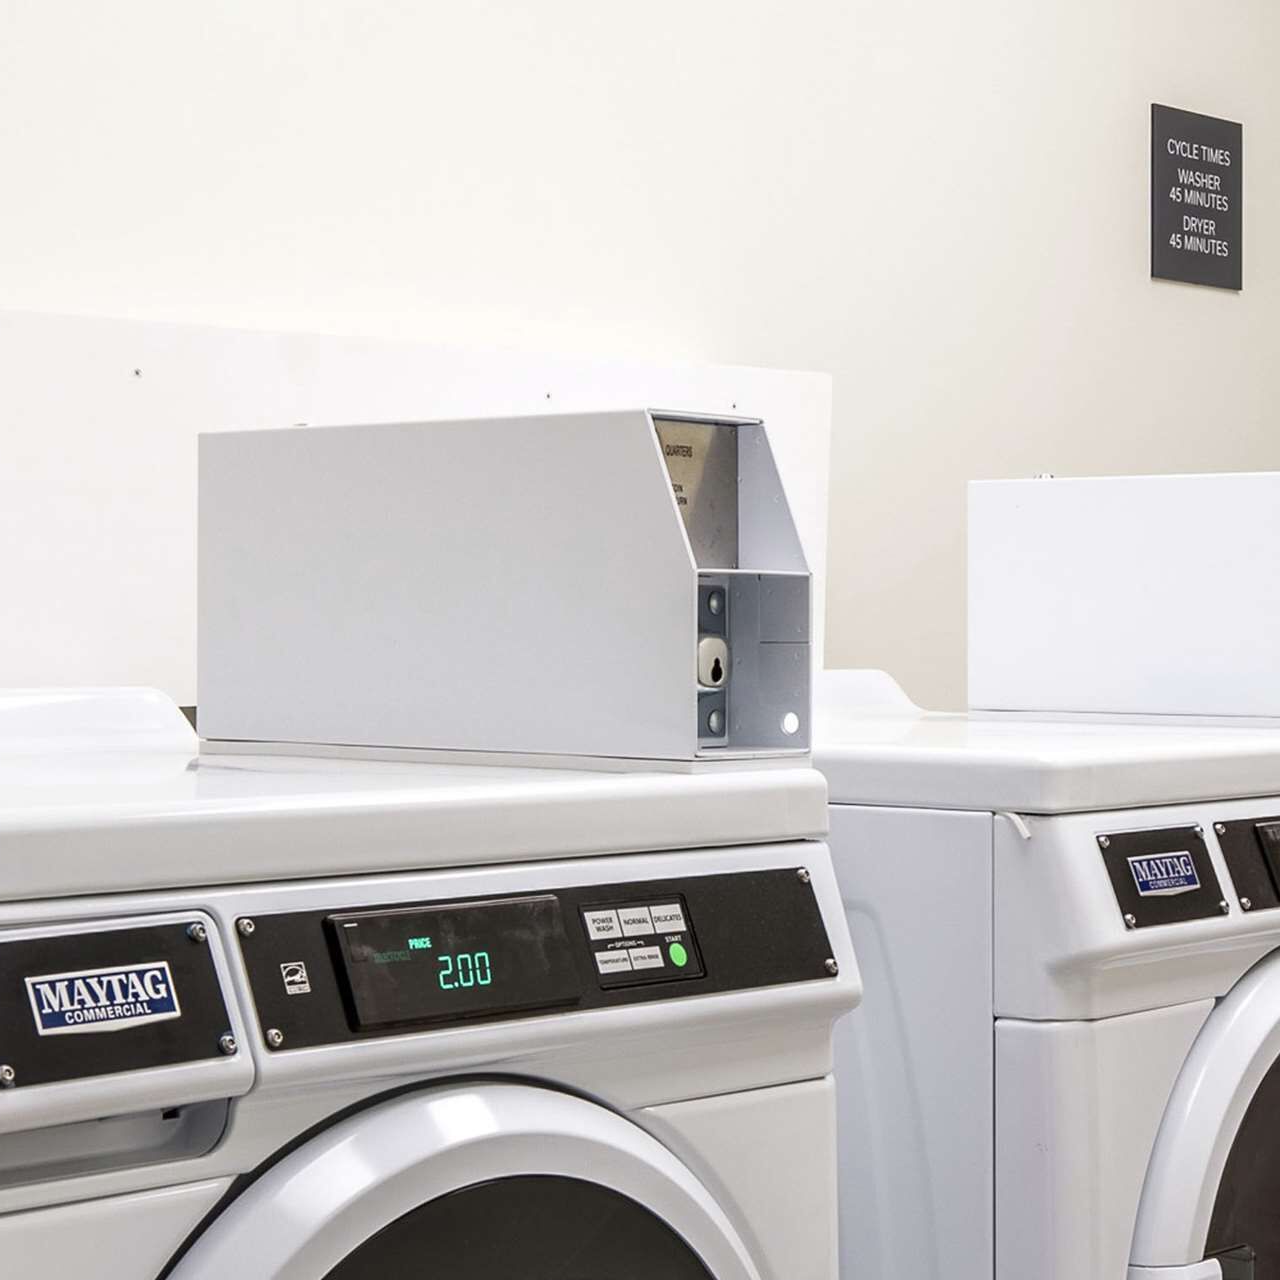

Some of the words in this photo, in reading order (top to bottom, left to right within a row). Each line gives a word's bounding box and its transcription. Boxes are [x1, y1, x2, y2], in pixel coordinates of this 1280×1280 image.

[1167, 138, 1200, 160] CYCLE
[1201, 145, 1231, 167] TIMES
[1177, 167, 1221, 191] WASHER
[1169, 186, 1182, 202] 45
[1184, 188, 1229, 212] MINUTES
[1183, 215, 1216, 236] DRYER
[1169, 233, 1182, 249] 45
[1184, 234, 1229, 257] MINUTES
[1133, 856, 1192, 882] MAYTAG
[1149, 877, 1188, 889] COMMERCIAL
[592, 917, 613, 925] POWER
[624, 918, 649, 926] NORMAL
[408, 937, 432, 950] PRICE
[665, 935, 681, 943] START
[437, 951, 492, 990] 2.00
[35, 969, 168, 1014] MAYTAG
[64, 1002, 152, 1024] COMMERCIAL
